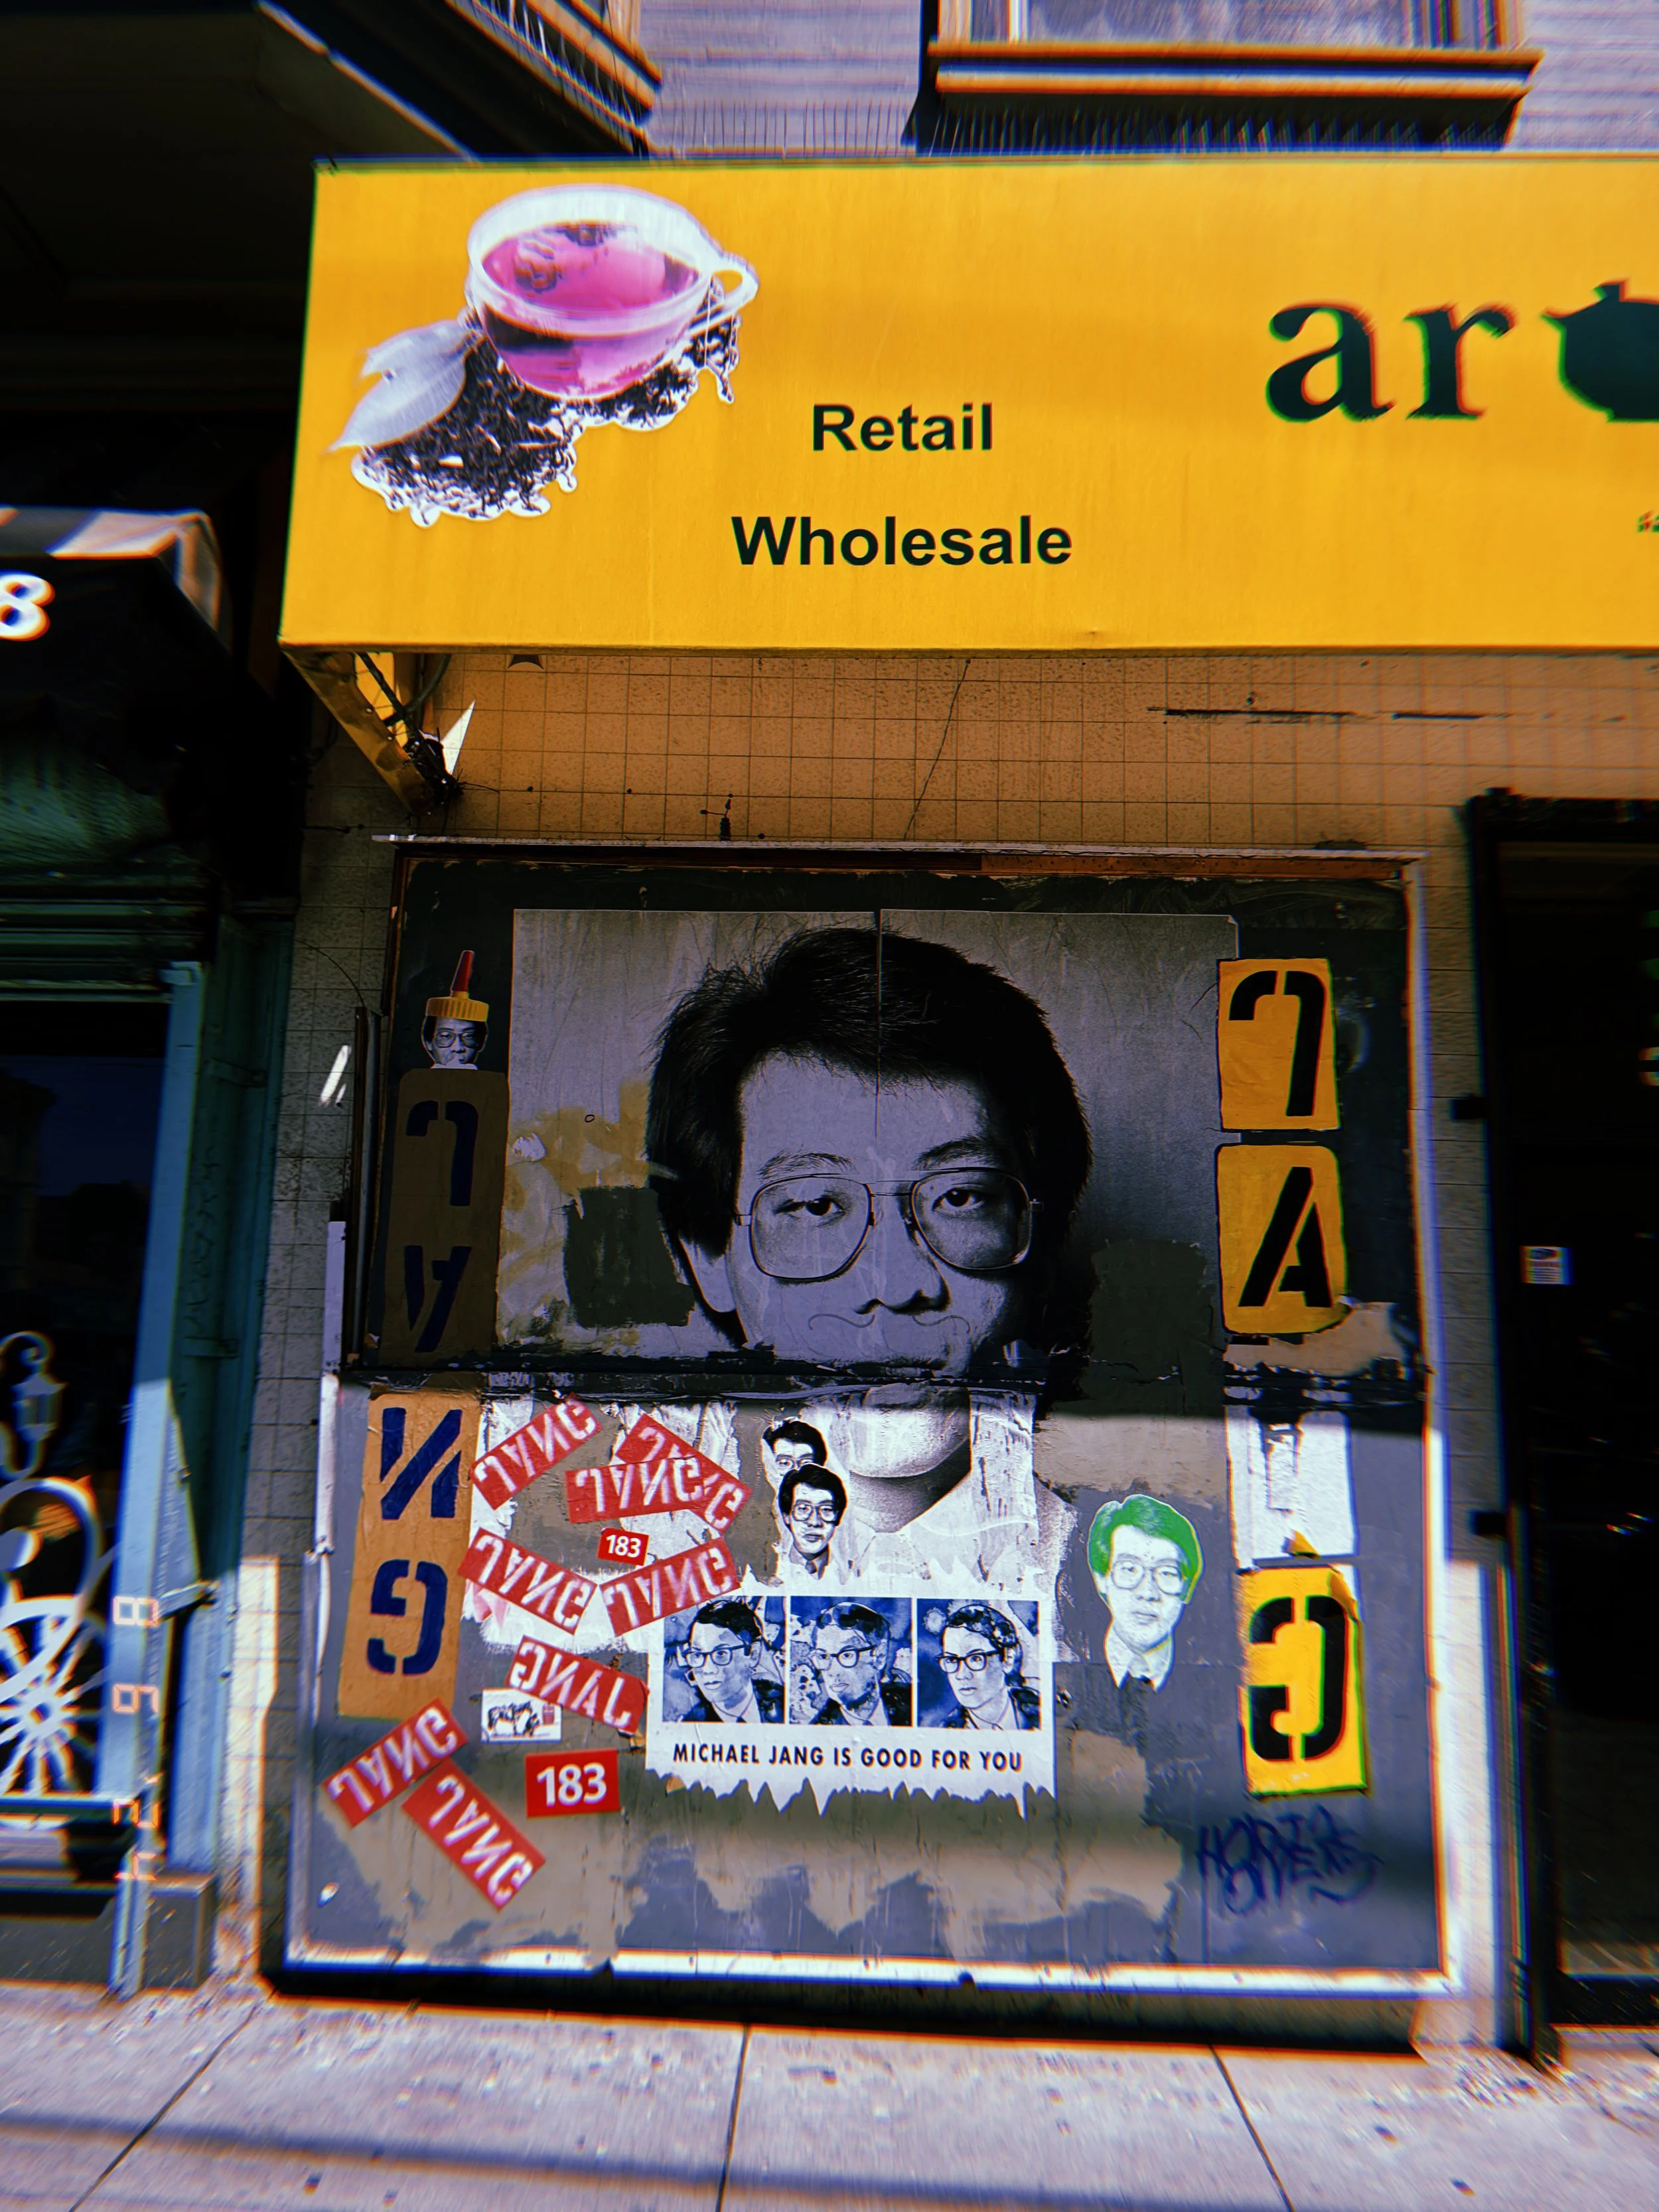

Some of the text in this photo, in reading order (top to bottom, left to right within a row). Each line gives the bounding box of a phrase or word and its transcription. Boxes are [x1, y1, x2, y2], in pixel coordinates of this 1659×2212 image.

[812, 402, 993, 452] Retail
[731, 514, 1072, 566] Wholesale
[606, 1534, 642, 1558] 183
[673, 1742, 1023, 1772] MICHAEL JANG IS GOOD FOR YOU
[536, 1763, 607, 1807] 183
